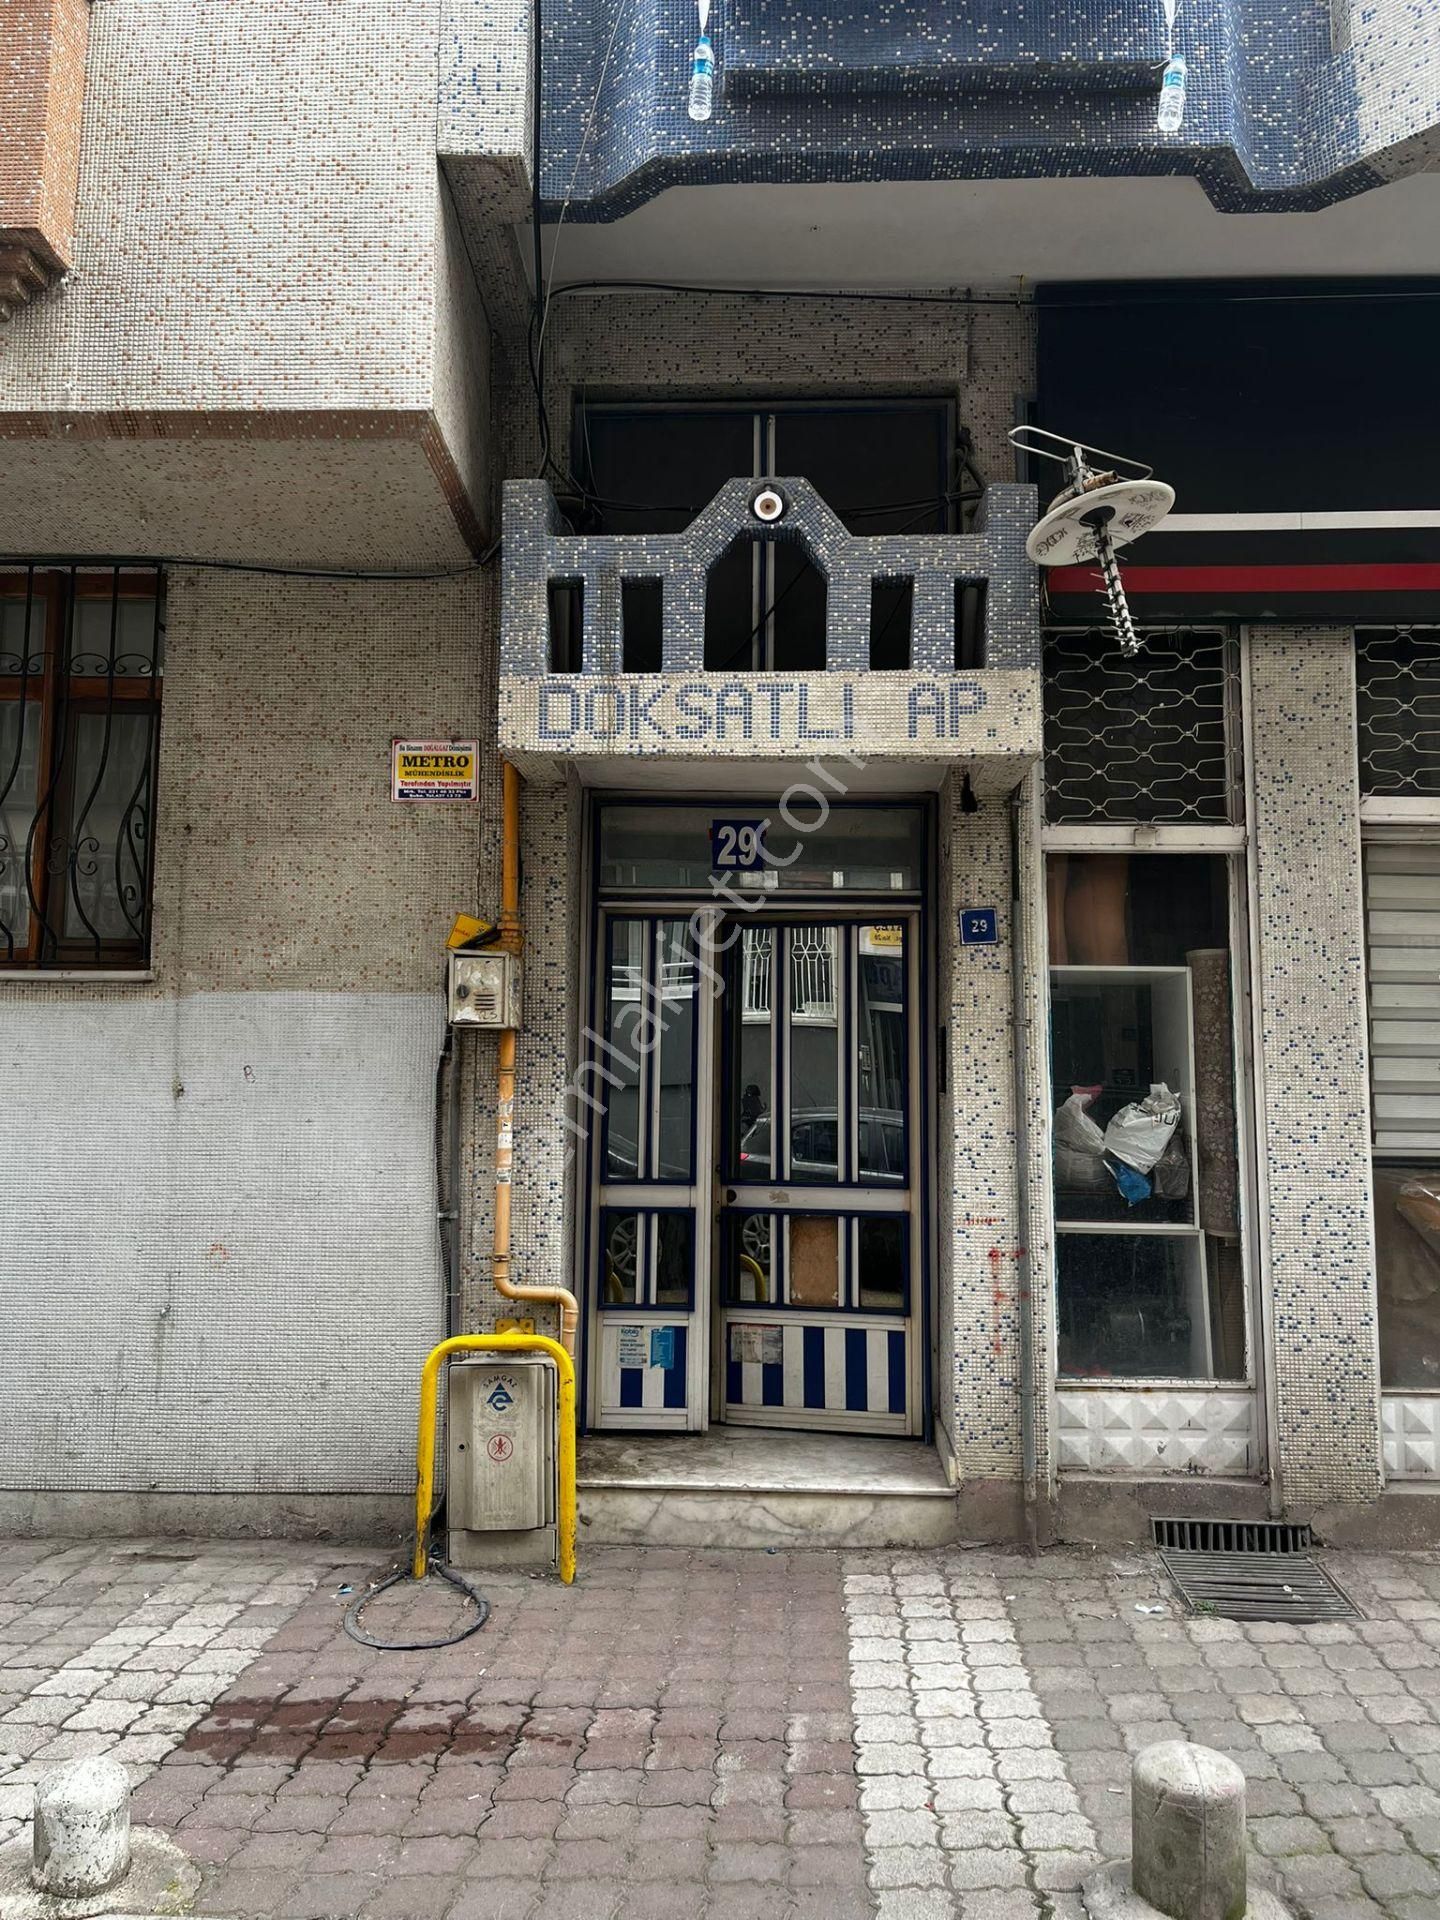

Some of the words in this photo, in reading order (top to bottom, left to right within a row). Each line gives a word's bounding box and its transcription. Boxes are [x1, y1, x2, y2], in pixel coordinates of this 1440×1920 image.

[538, 682, 854, 740] DOKSATLI
[908, 681, 997, 739] AP.
[402, 755, 469, 767] METRO
[716, 825, 758, 866] 29
[970, 918, 988, 933] 29
[483, 1374, 518, 1388] SAMGAZ
